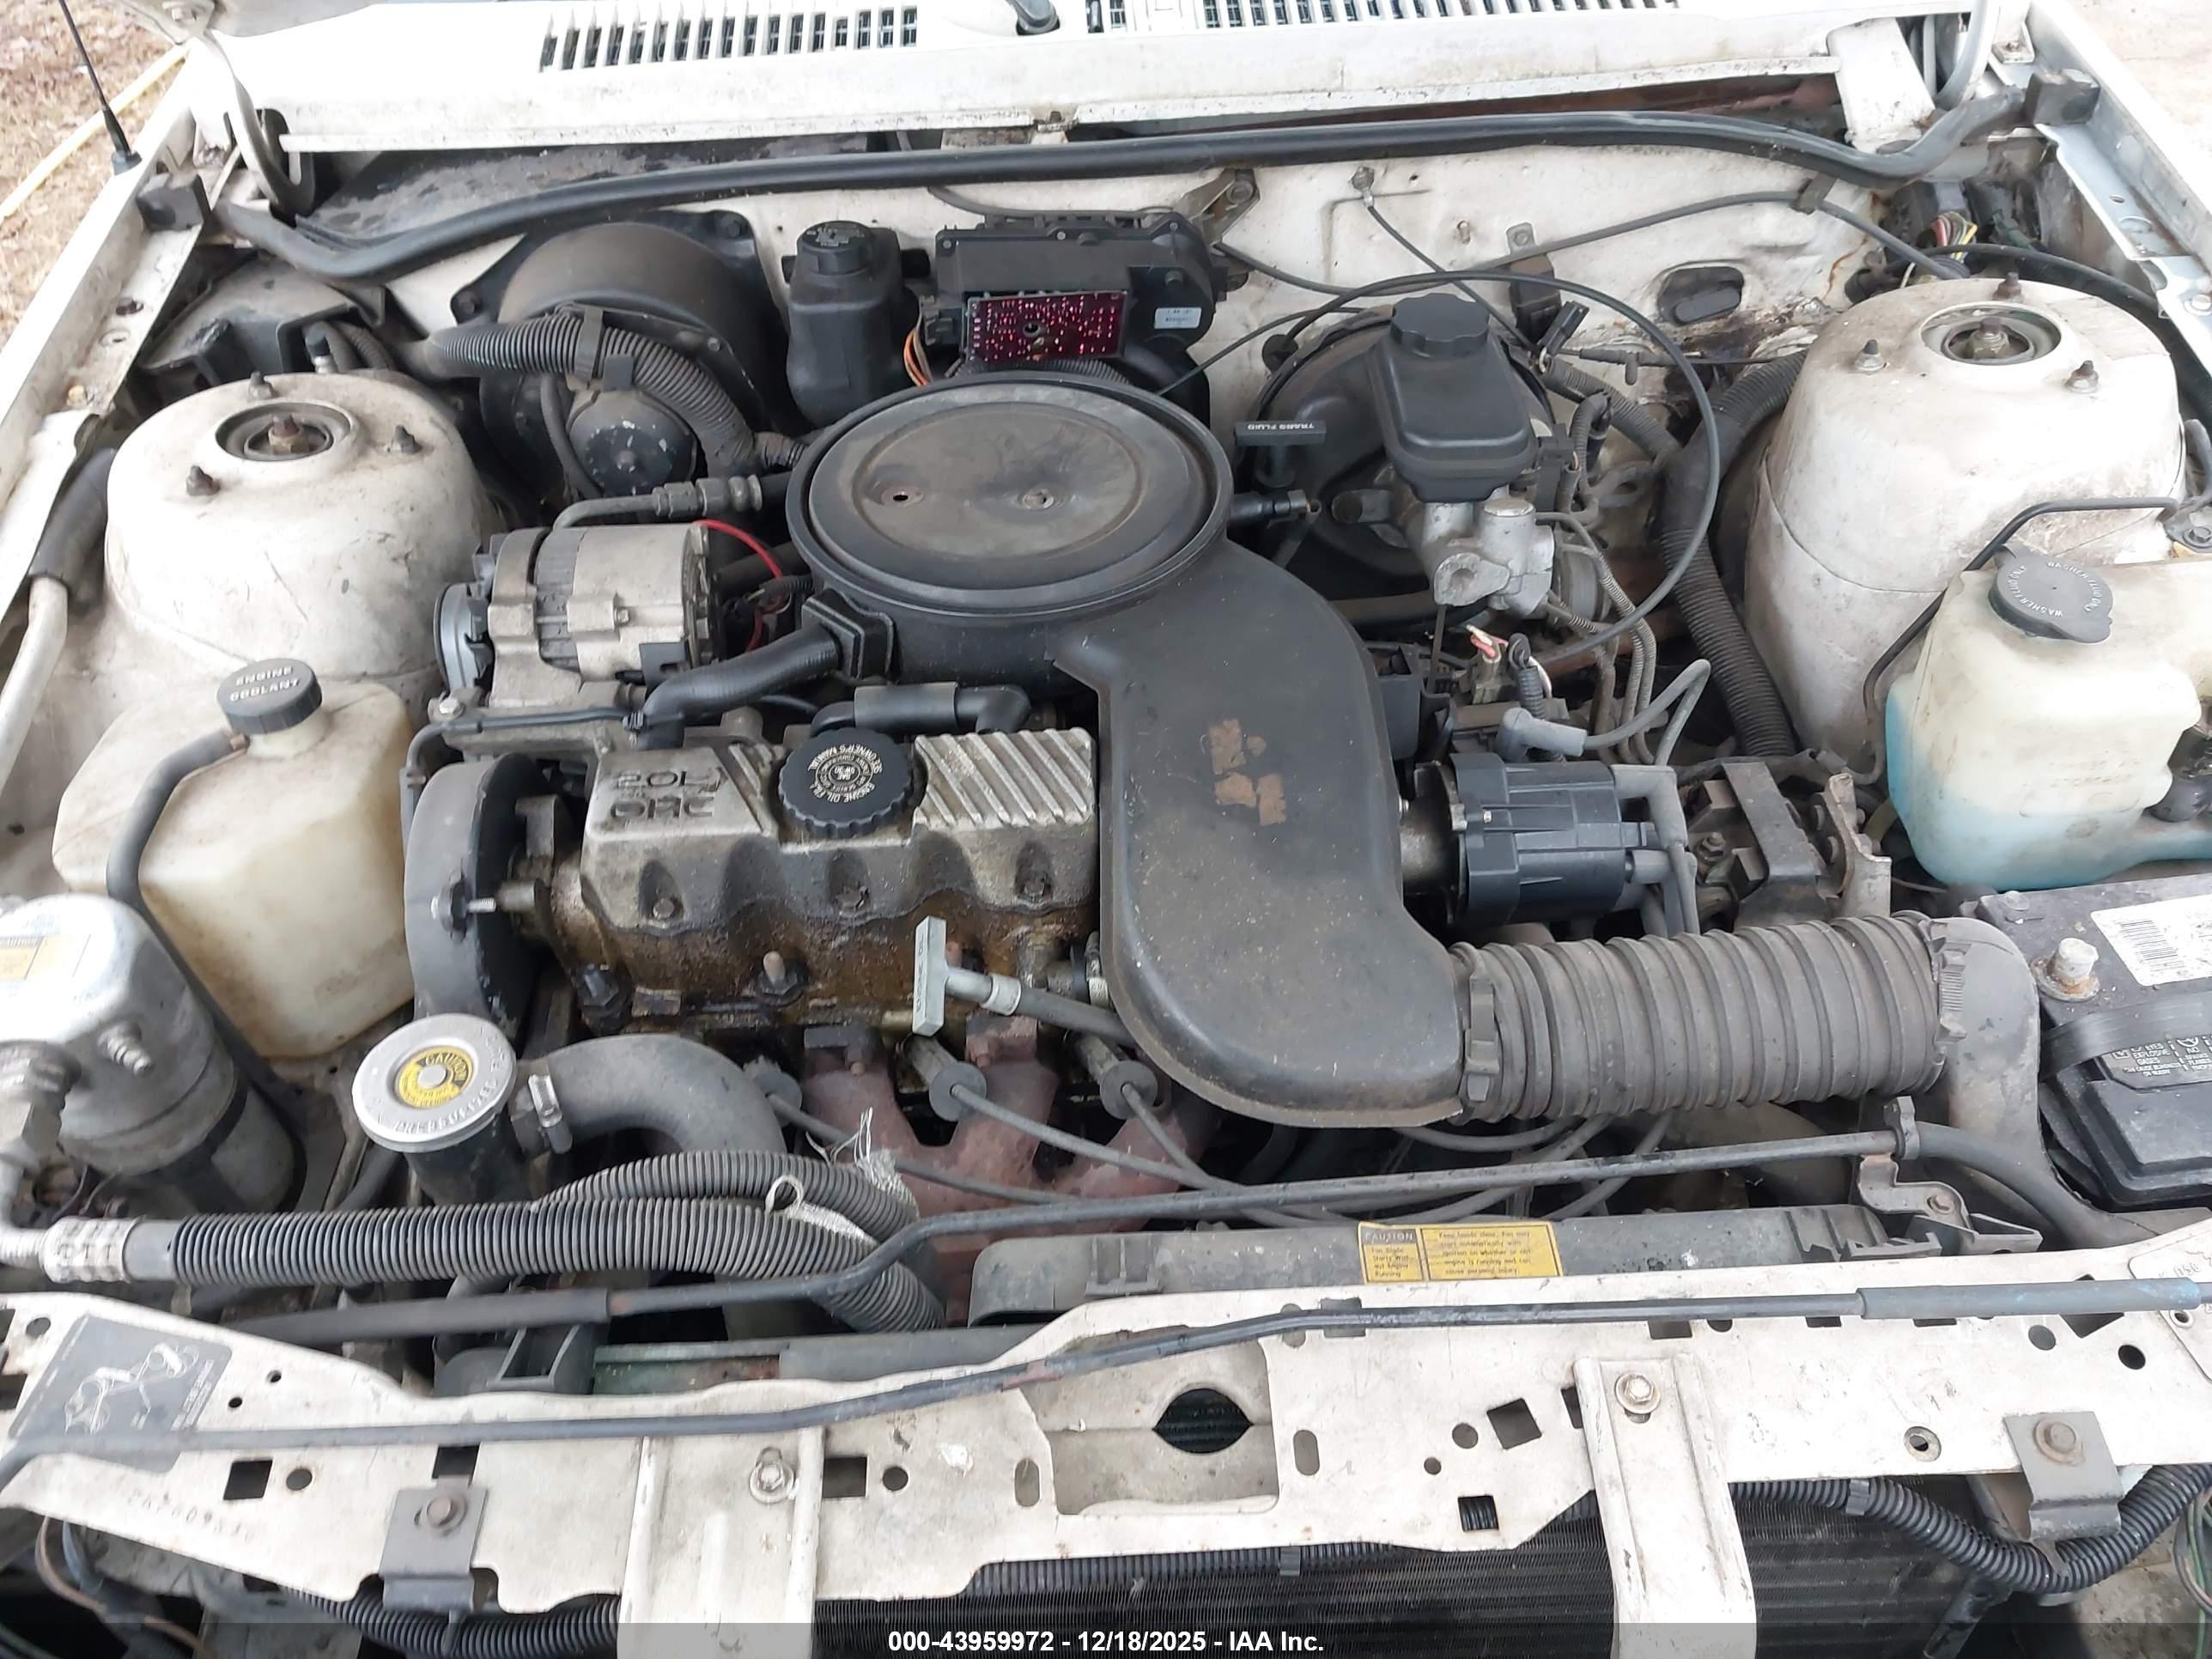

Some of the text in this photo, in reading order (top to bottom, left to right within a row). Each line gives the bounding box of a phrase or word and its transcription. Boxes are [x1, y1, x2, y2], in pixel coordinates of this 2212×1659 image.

[2047, 561, 2088, 579] WASHER
[2020, 598, 2063, 617] WASHER
[236, 665, 293, 686] ENGINE
[230, 678, 300, 702] COOLANT
[827, 792, 841, 803] OIL
[611, 797, 714, 819] OHC
[425, 1052, 468, 1081] CAUTION
[1364, 1231, 1413, 1241] CAUTION
